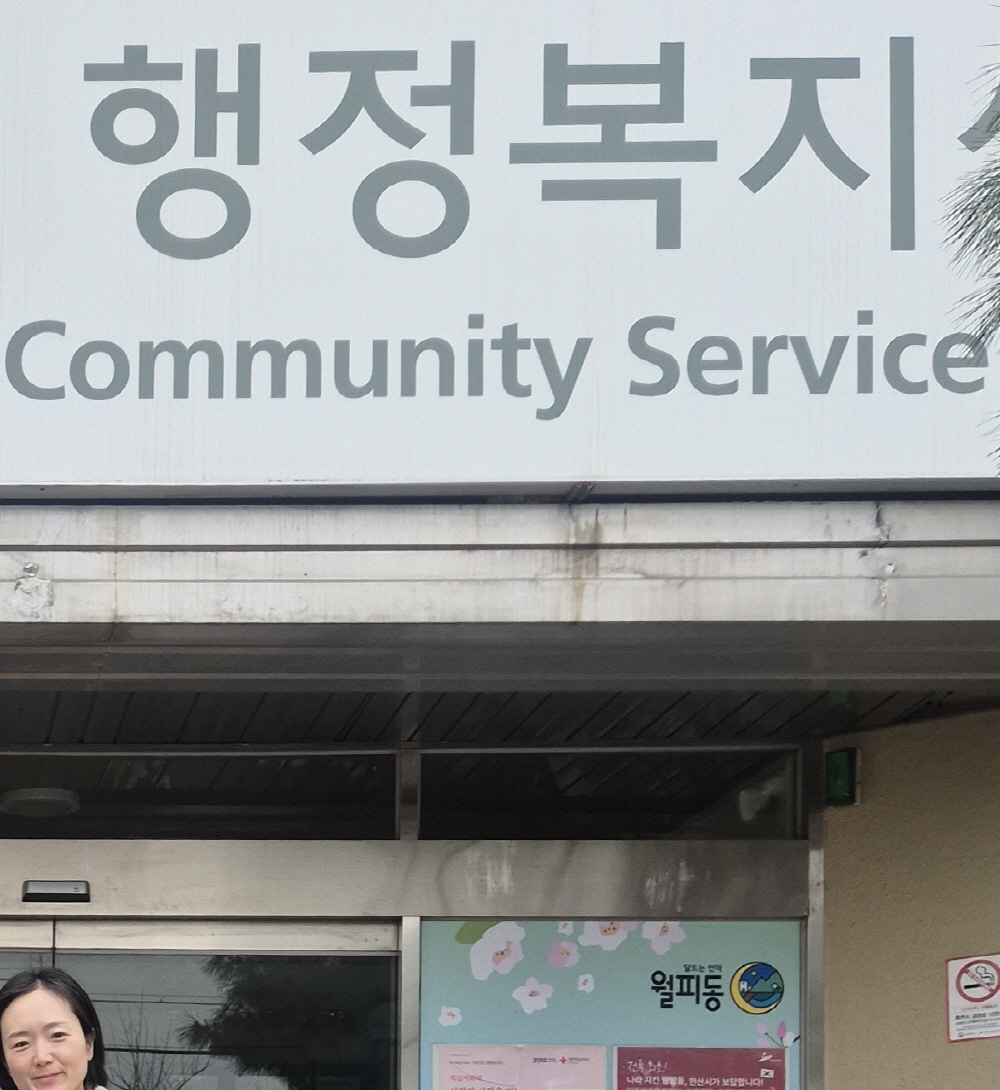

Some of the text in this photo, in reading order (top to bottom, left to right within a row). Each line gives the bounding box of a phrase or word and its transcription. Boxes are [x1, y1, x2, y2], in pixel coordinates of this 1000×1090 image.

[83, 37, 1000, 261] 행정복지
[4, 313, 593, 422] Community
[628, 310, 988, 398] Service
[650, 970, 725, 1012] 월피동
[626, 1076, 643, 1085] 나라
[644, 1076, 660, 1085] 지킨
[688, 1077, 720, 1086] 안산시가
[722, 1077, 764, 1087] 보답합니다!
